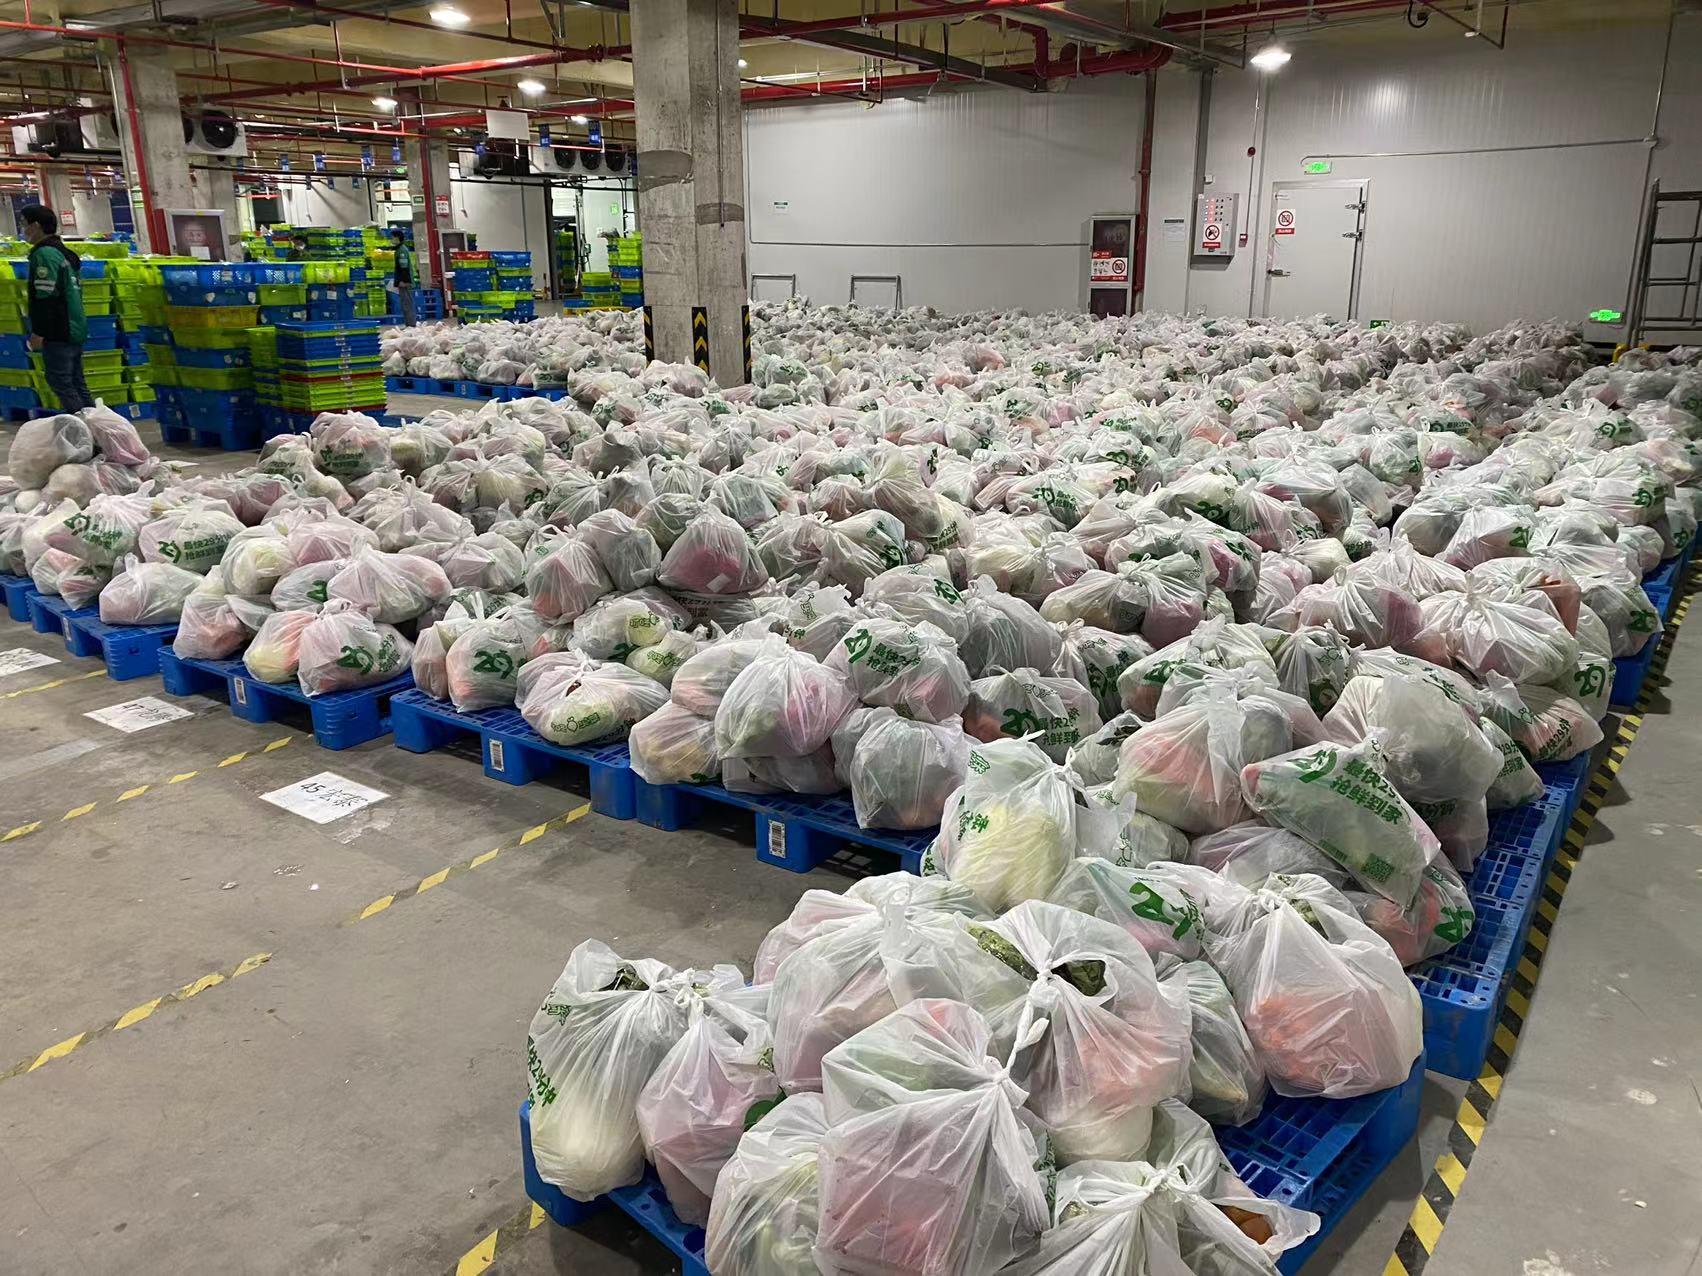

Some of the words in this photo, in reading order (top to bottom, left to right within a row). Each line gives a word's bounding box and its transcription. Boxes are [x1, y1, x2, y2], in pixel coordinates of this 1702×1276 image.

[473, 650, 514, 680] 29
[1574, 663, 1607, 698] 29
[300, 782, 327, 794] 45
[1329, 774, 1403, 825] 抢鲜到家
